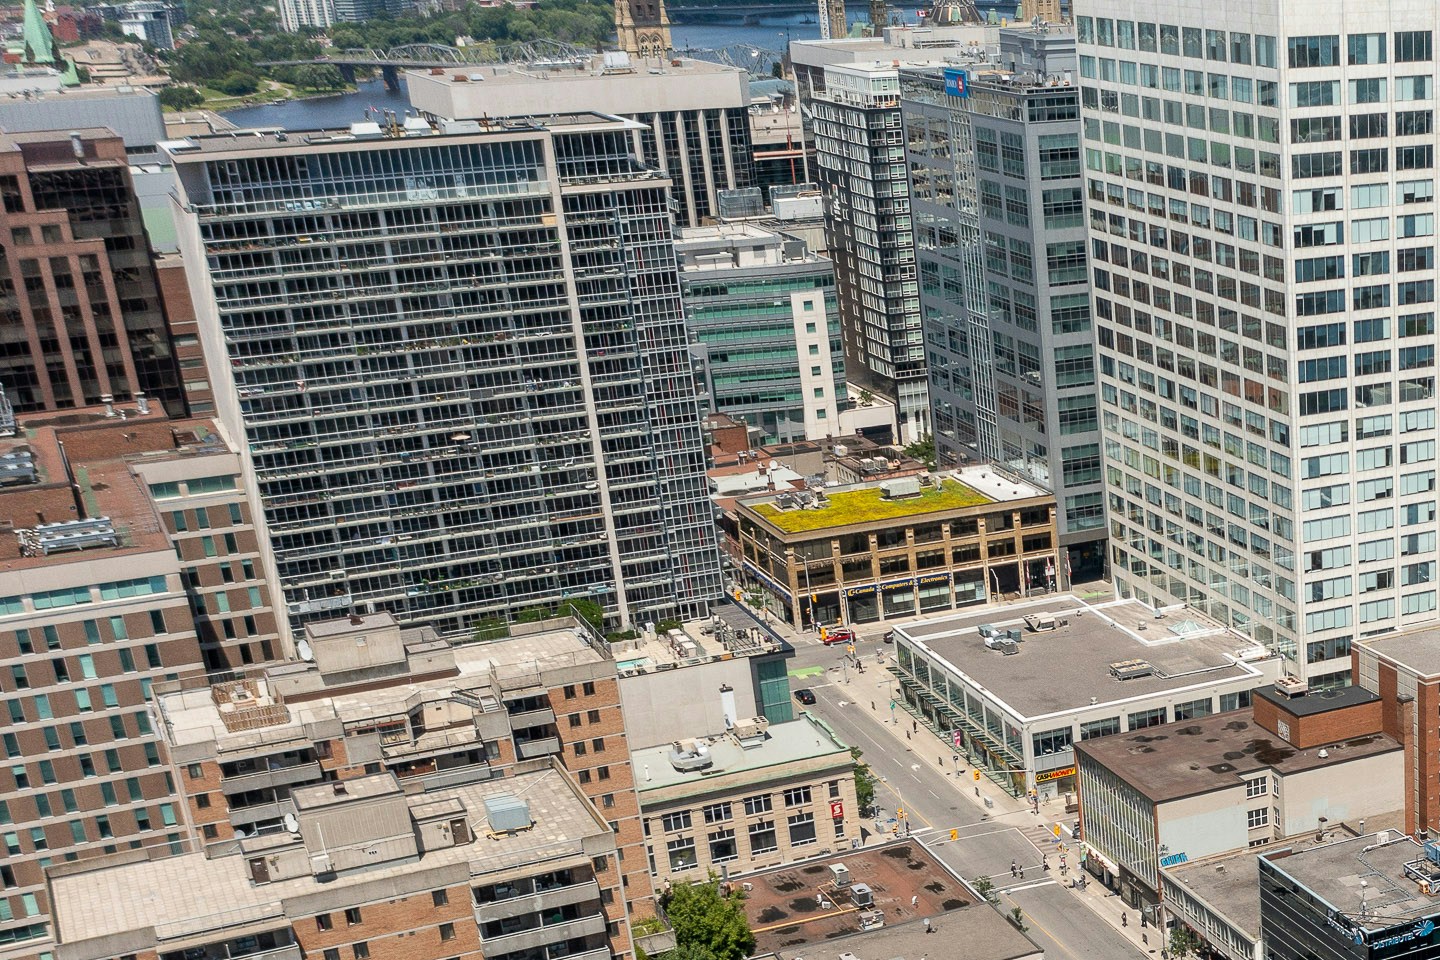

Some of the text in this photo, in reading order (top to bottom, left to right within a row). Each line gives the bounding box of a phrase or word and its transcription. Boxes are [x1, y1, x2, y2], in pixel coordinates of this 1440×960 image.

[881, 581, 908, 591] Computers
[920, 575, 948, 584] Electronics
[1036, 768, 1074, 781] CASH MONEY
[1372, 932, 1416, 950] DISTRIBUTEL
